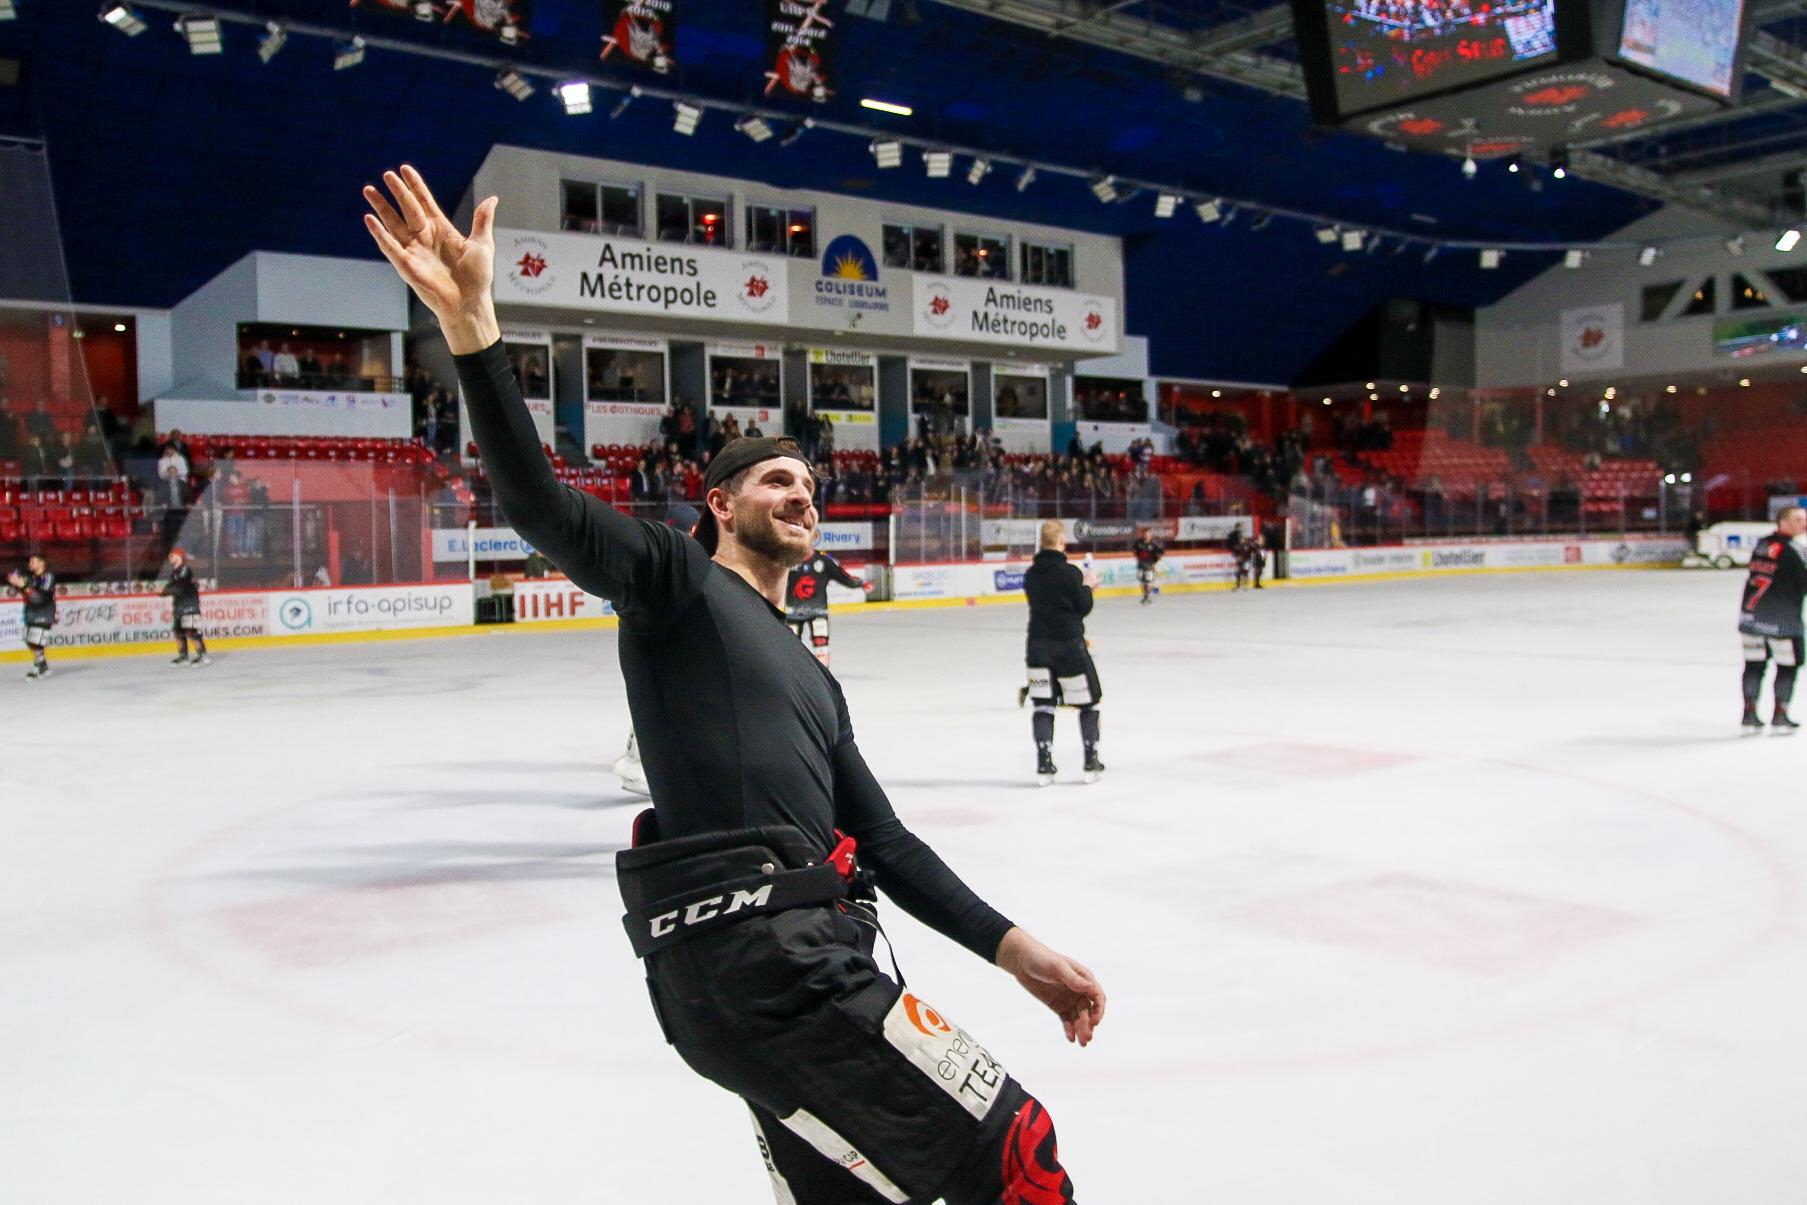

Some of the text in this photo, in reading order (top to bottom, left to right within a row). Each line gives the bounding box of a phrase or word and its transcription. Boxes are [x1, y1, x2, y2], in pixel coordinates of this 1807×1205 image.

[599, 243, 699, 276] Amiens
[579, 272, 717, 309] Métropole
[815, 280, 888, 298] COLISEUM
[984, 286, 1054, 314] Amiens
[971, 310, 1067, 341] Métropole
[519, 591, 585, 619] IIHF
[1746, 575, 1773, 611] 7
[649, 884, 773, 938] CCM
